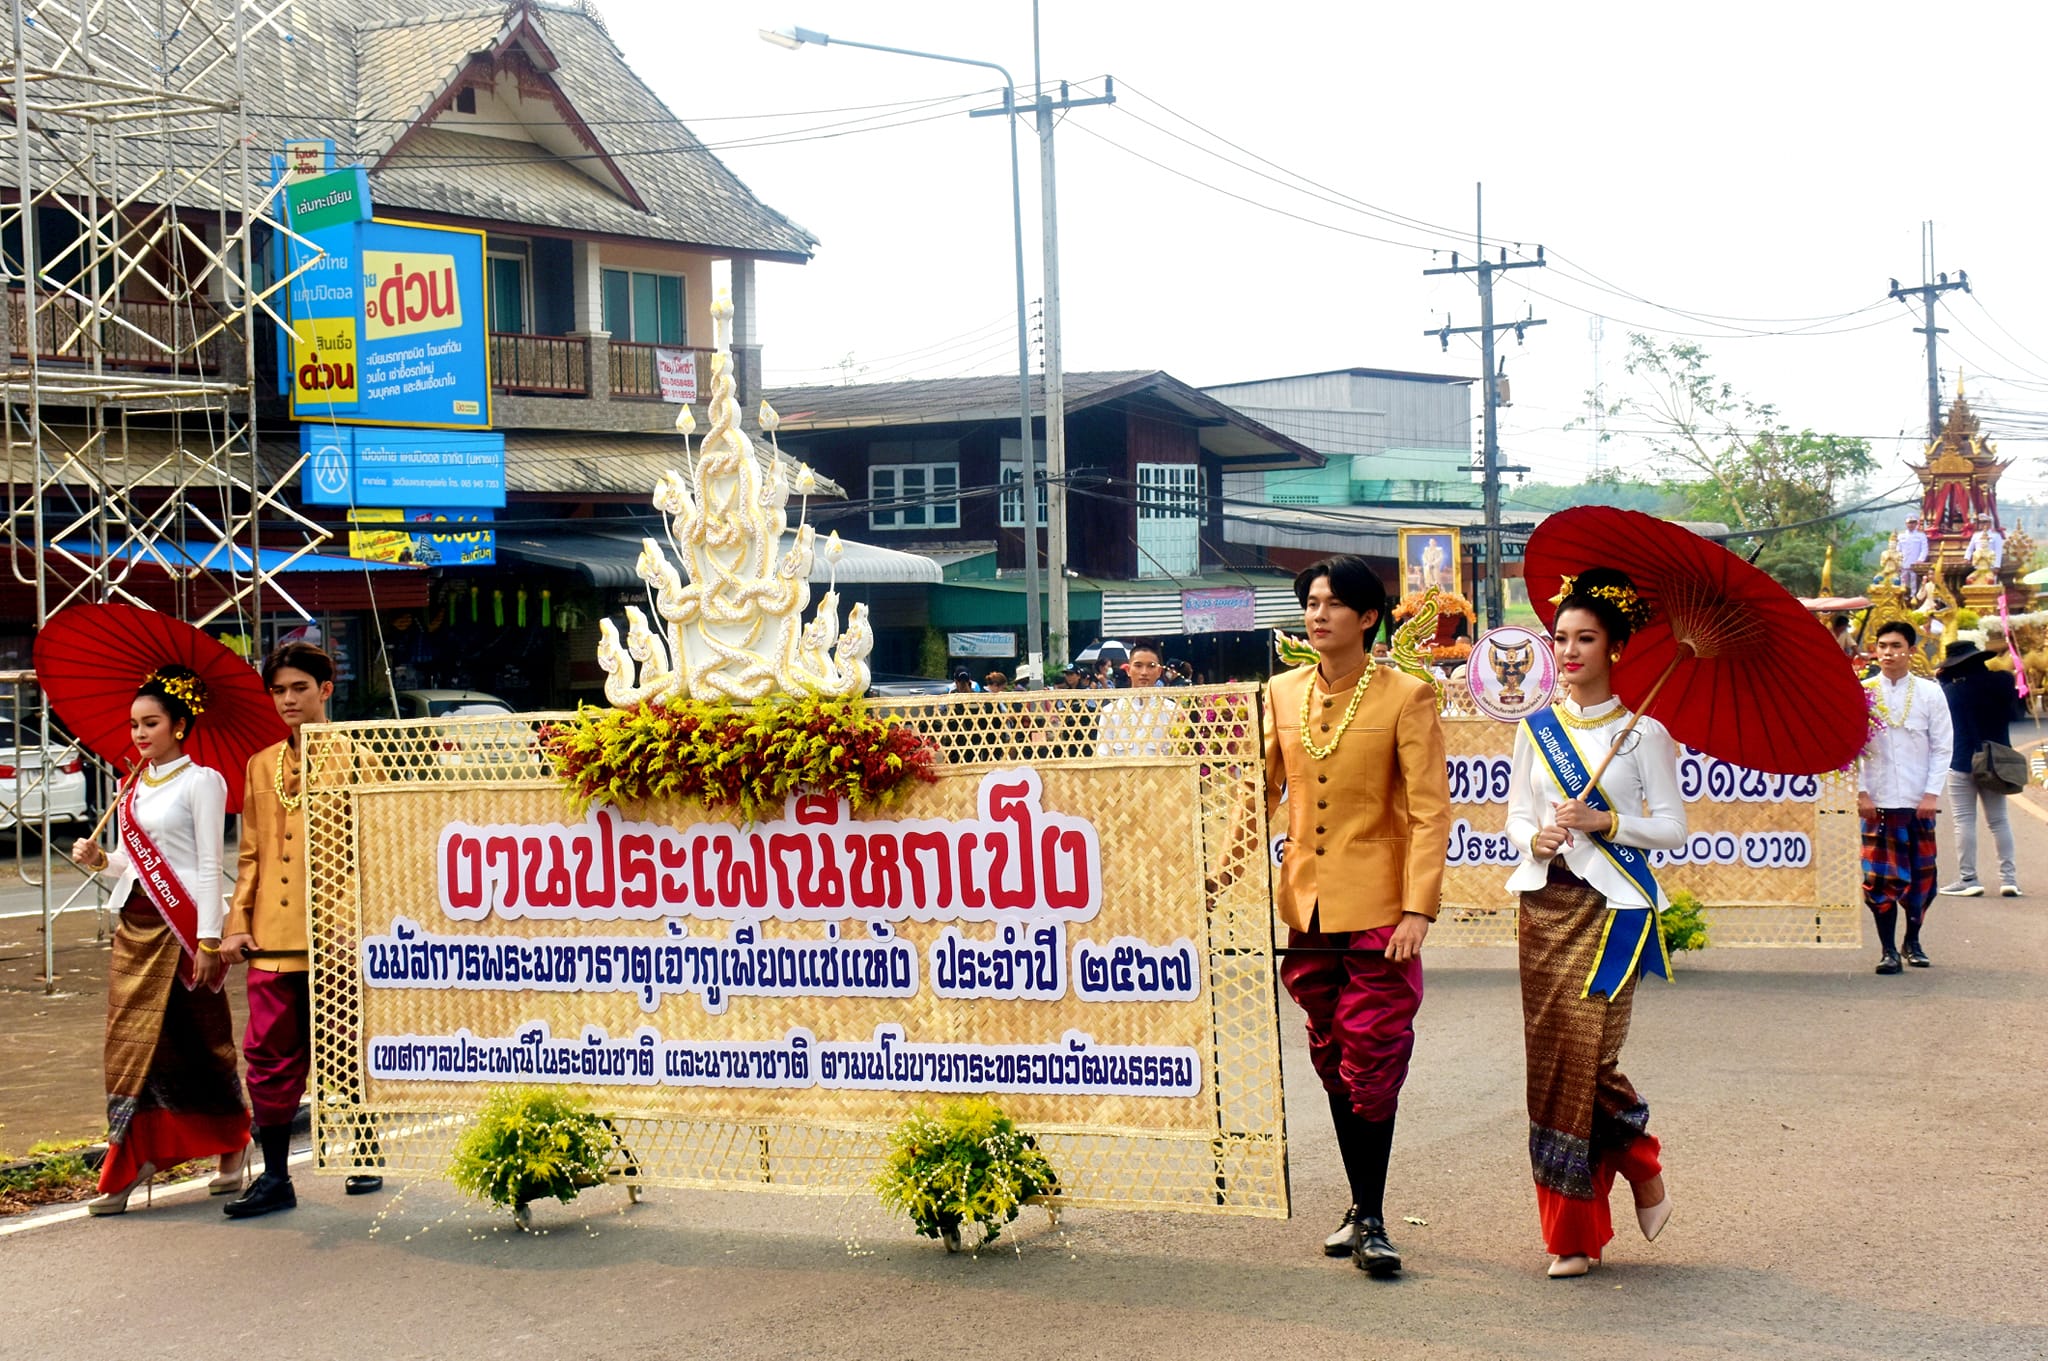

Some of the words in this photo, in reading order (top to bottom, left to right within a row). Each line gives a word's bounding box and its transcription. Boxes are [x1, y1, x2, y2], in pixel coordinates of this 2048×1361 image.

[296, 190, 353, 215] เล่มทะเบียน
[379, 262, 455, 327] ด่วน
[298, 352, 355, 391] ด่วน
[1538, 726, 1583, 792] รองชนะเลิศอันดับ
[126, 830, 161, 872] ประจำปี
[150, 870, 180, 908] ๒๕๖๗
[446, 779, 1090, 910] งานประเพณีหกเป็ง
[1745, 837, 1806, 863] บาท
[937, 925, 1058, 991] ประจำปี
[1080, 946, 1192, 992] ๒๕๖๗
[374, 1029, 655, 1077] เทศกาลประเพณีในระดับชาติ
[665, 1036, 809, 1079] และนานาชาติ
[821, 1033, 1193, 1087] ตามนโยบายกระทรวงวัฒนธรรม
